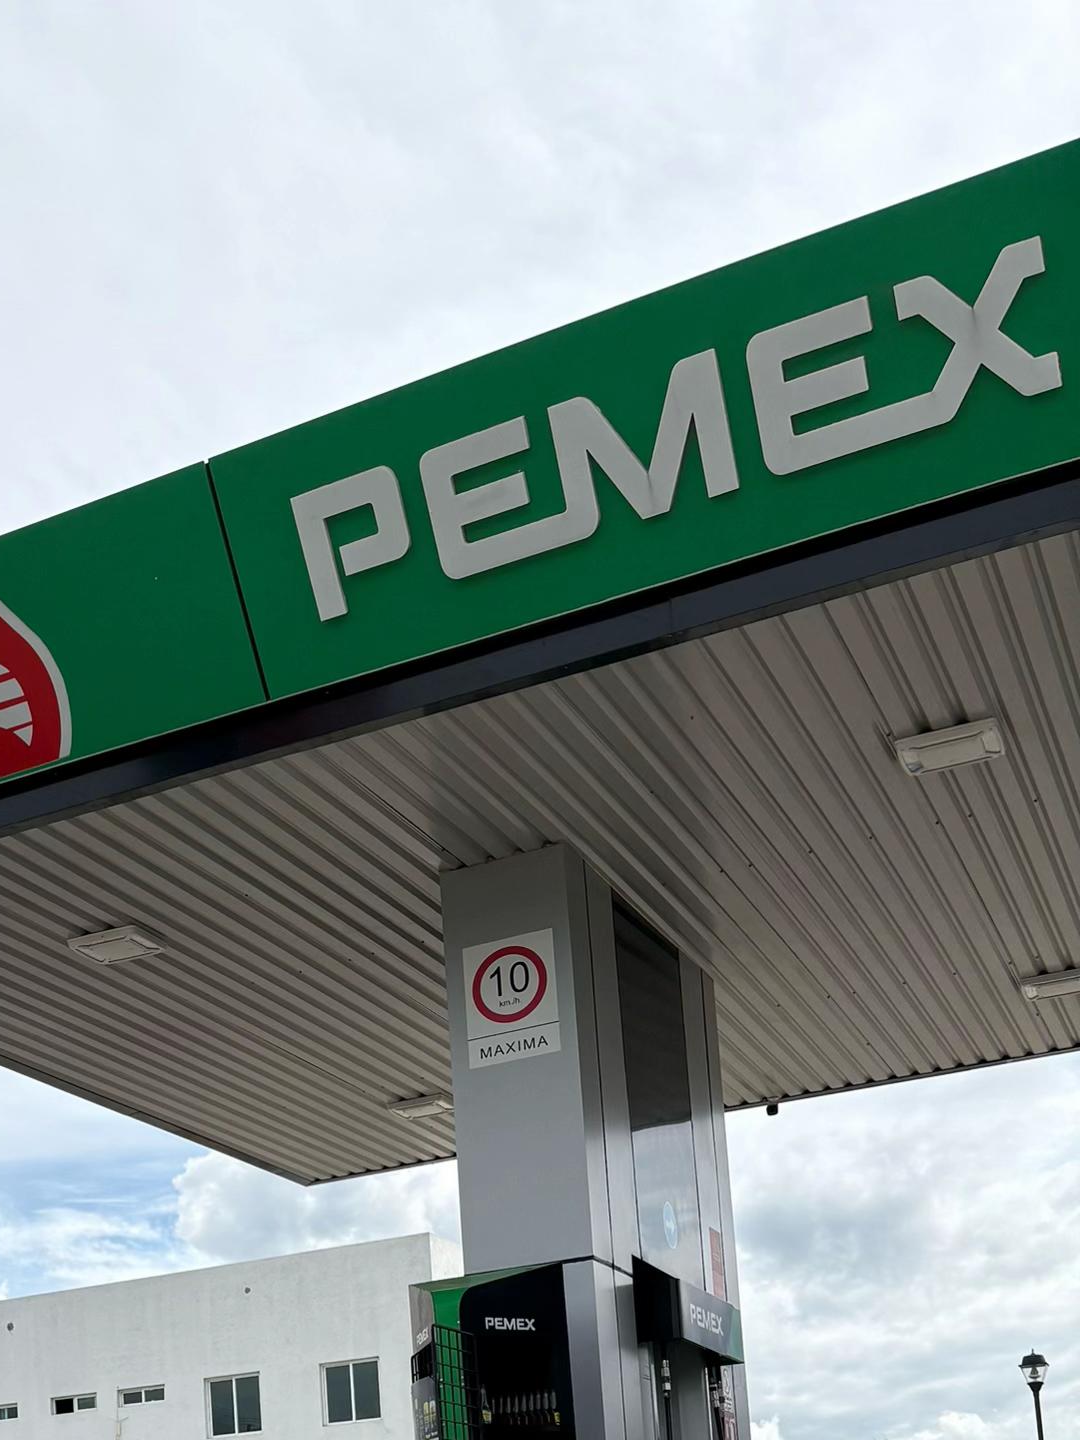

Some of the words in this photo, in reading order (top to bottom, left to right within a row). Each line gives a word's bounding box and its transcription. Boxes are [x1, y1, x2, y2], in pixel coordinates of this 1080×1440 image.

[290, 235, 1063, 622] PEMEX
[489, 961, 530, 997] 10
[480, 1035, 549, 1059] MAXIMA
[485, 1317, 536, 1331] PEMEX
[690, 1303, 724, 1337] PEMEX
